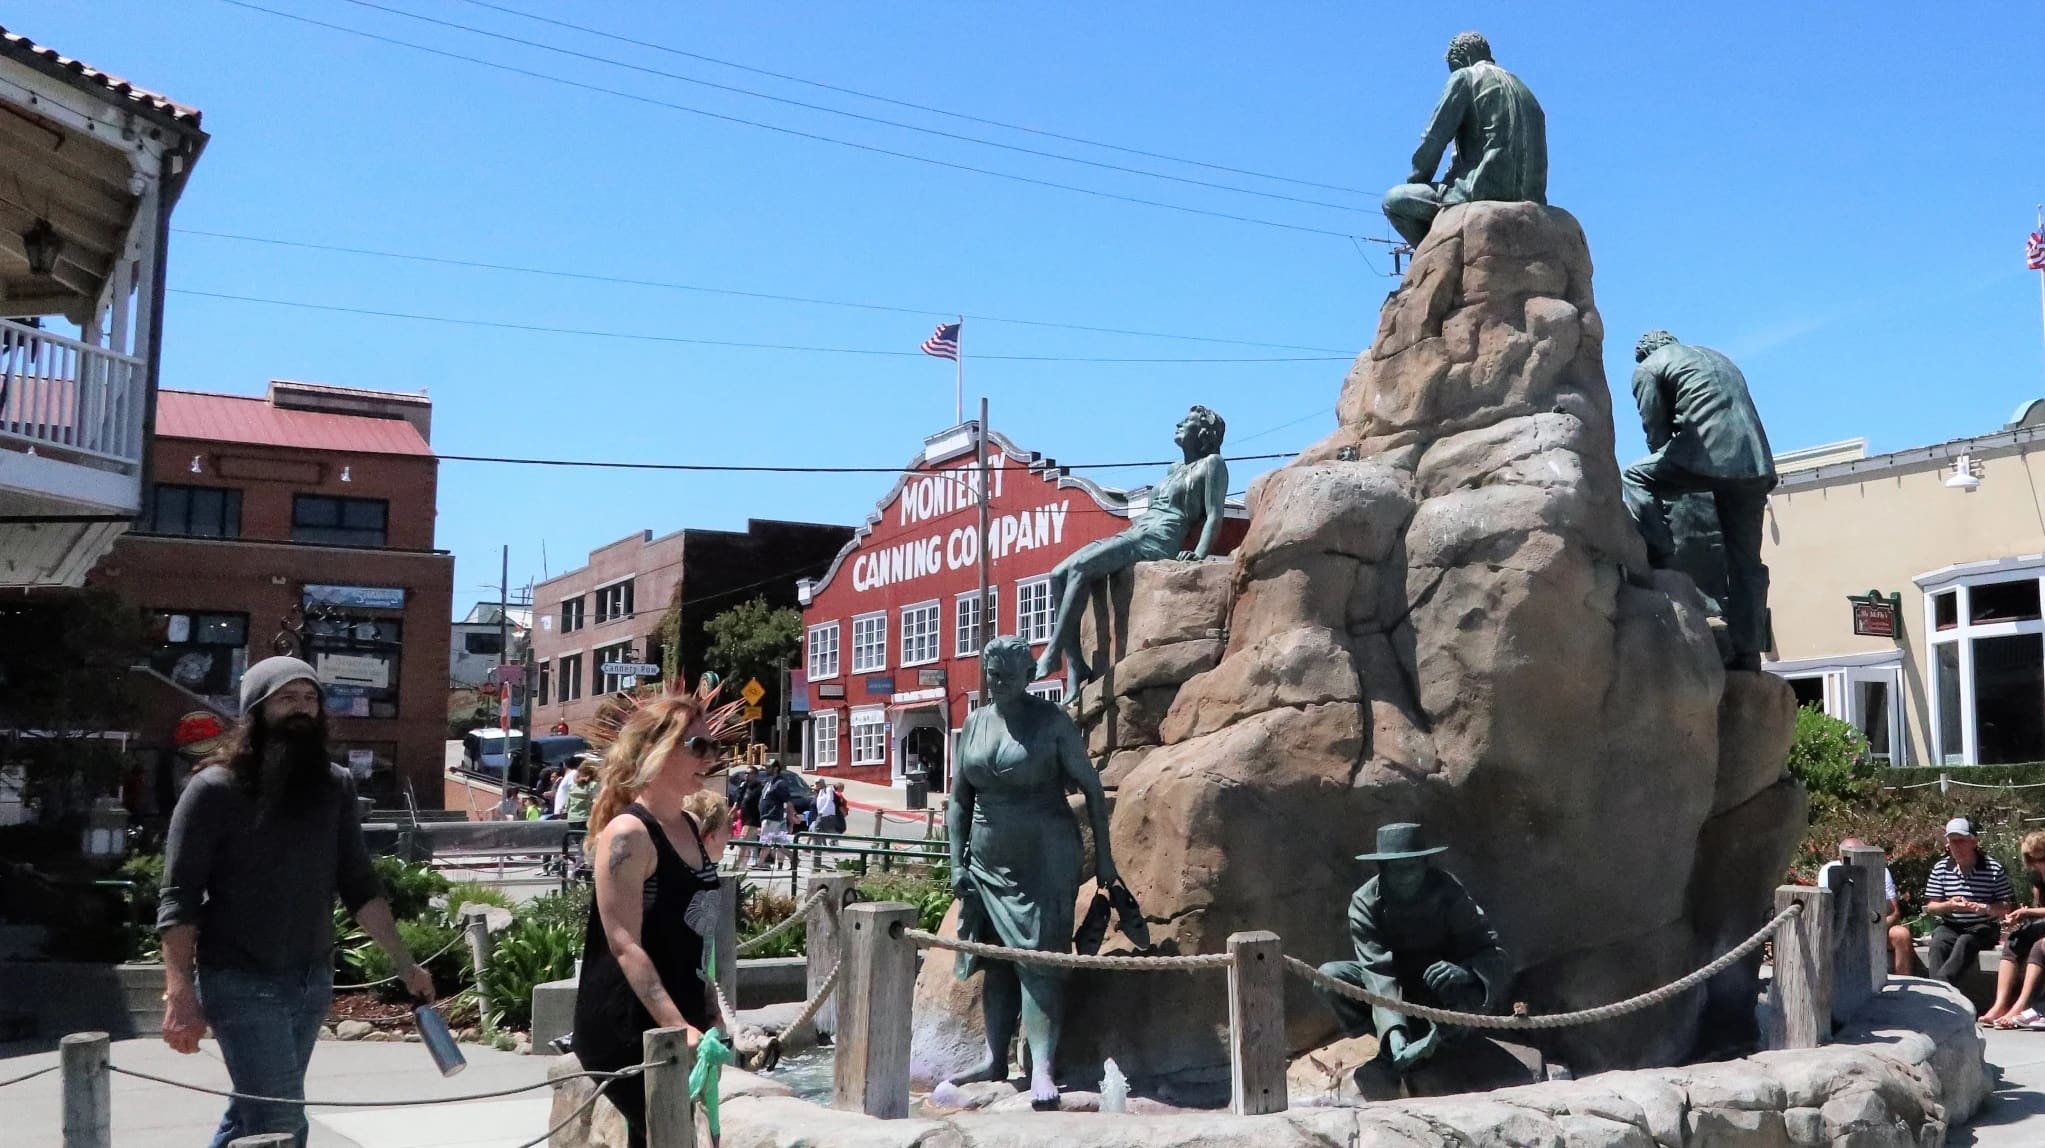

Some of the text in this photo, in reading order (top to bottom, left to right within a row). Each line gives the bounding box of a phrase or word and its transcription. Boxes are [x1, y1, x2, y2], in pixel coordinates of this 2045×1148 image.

[901, 451, 1006, 526] MONTERY
[853, 500, 1069, 592] CANNING COMPANY
[604, 664, 657, 674] Cannery Row
